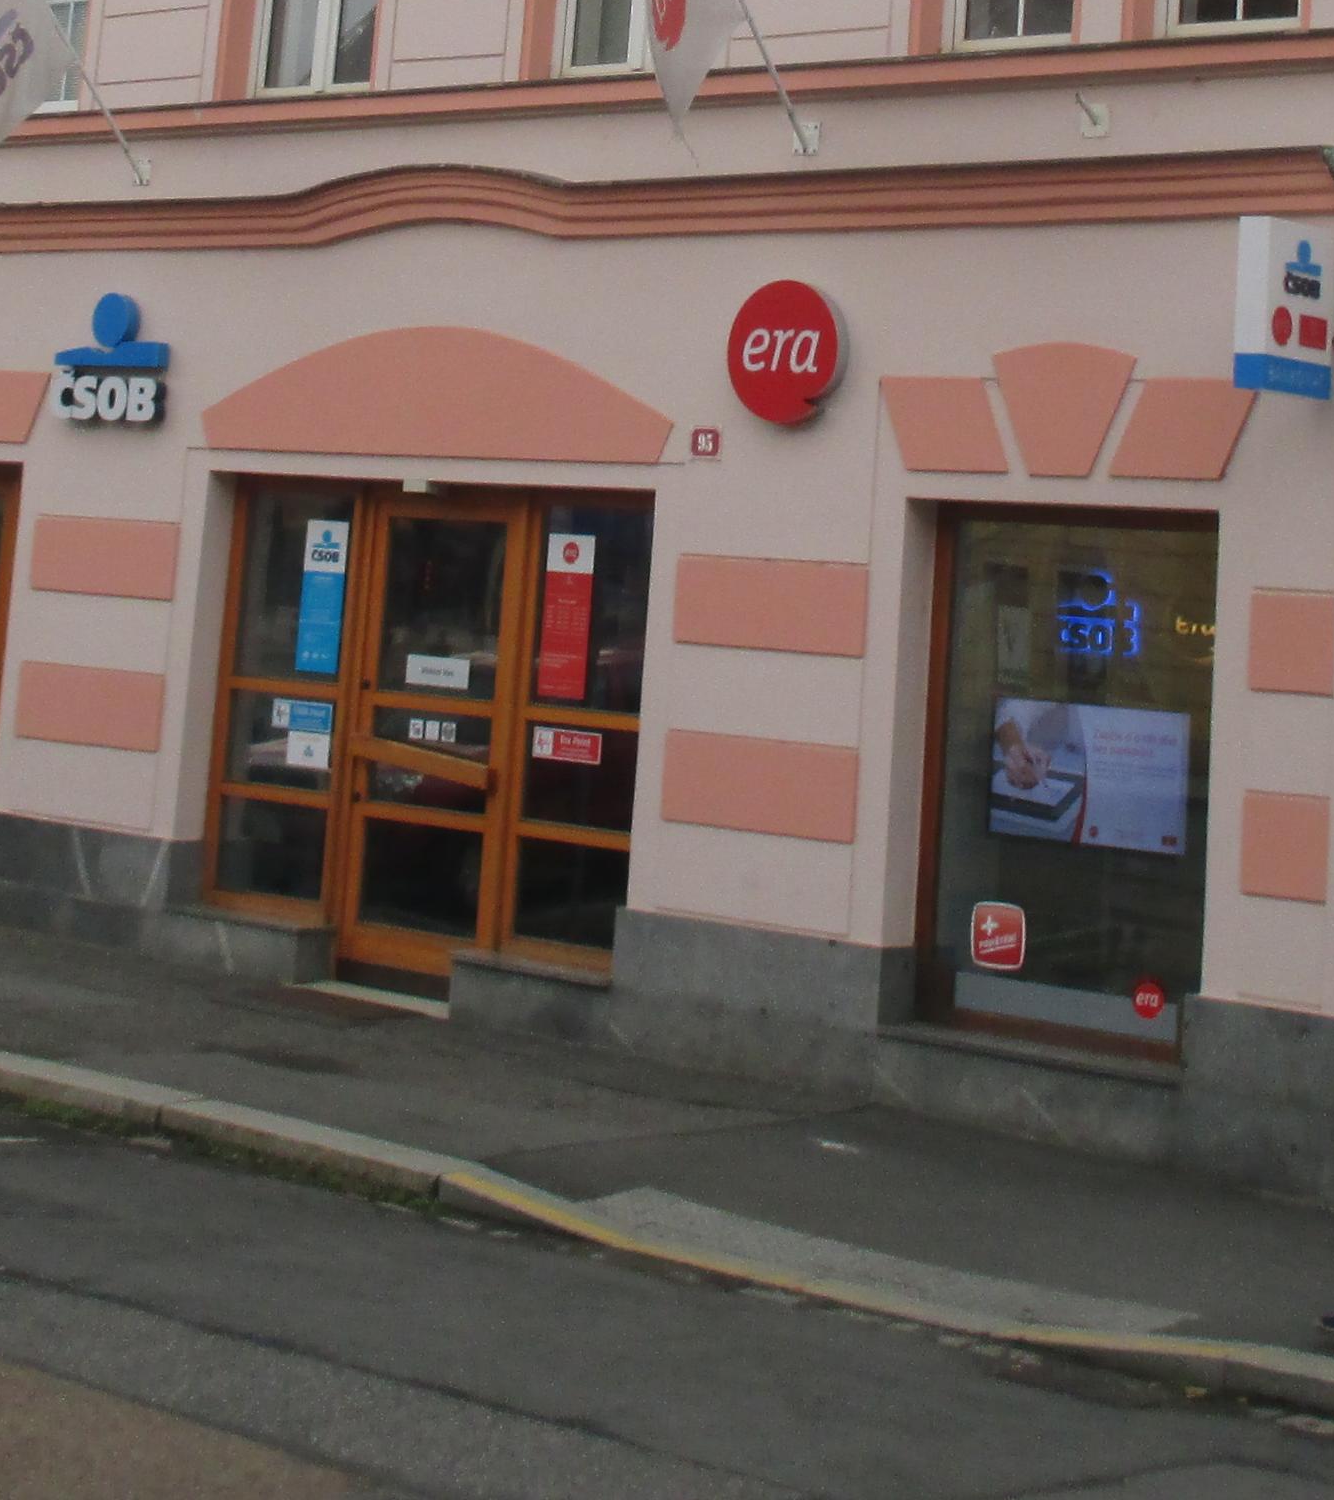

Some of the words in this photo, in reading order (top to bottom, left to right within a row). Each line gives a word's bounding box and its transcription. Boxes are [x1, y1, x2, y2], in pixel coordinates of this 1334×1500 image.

[742, 328, 820, 373] era
[51, 368, 157, 422] ČSOB
[697, 433, 714, 453] 95
[1135, 992, 1159, 1007] era
